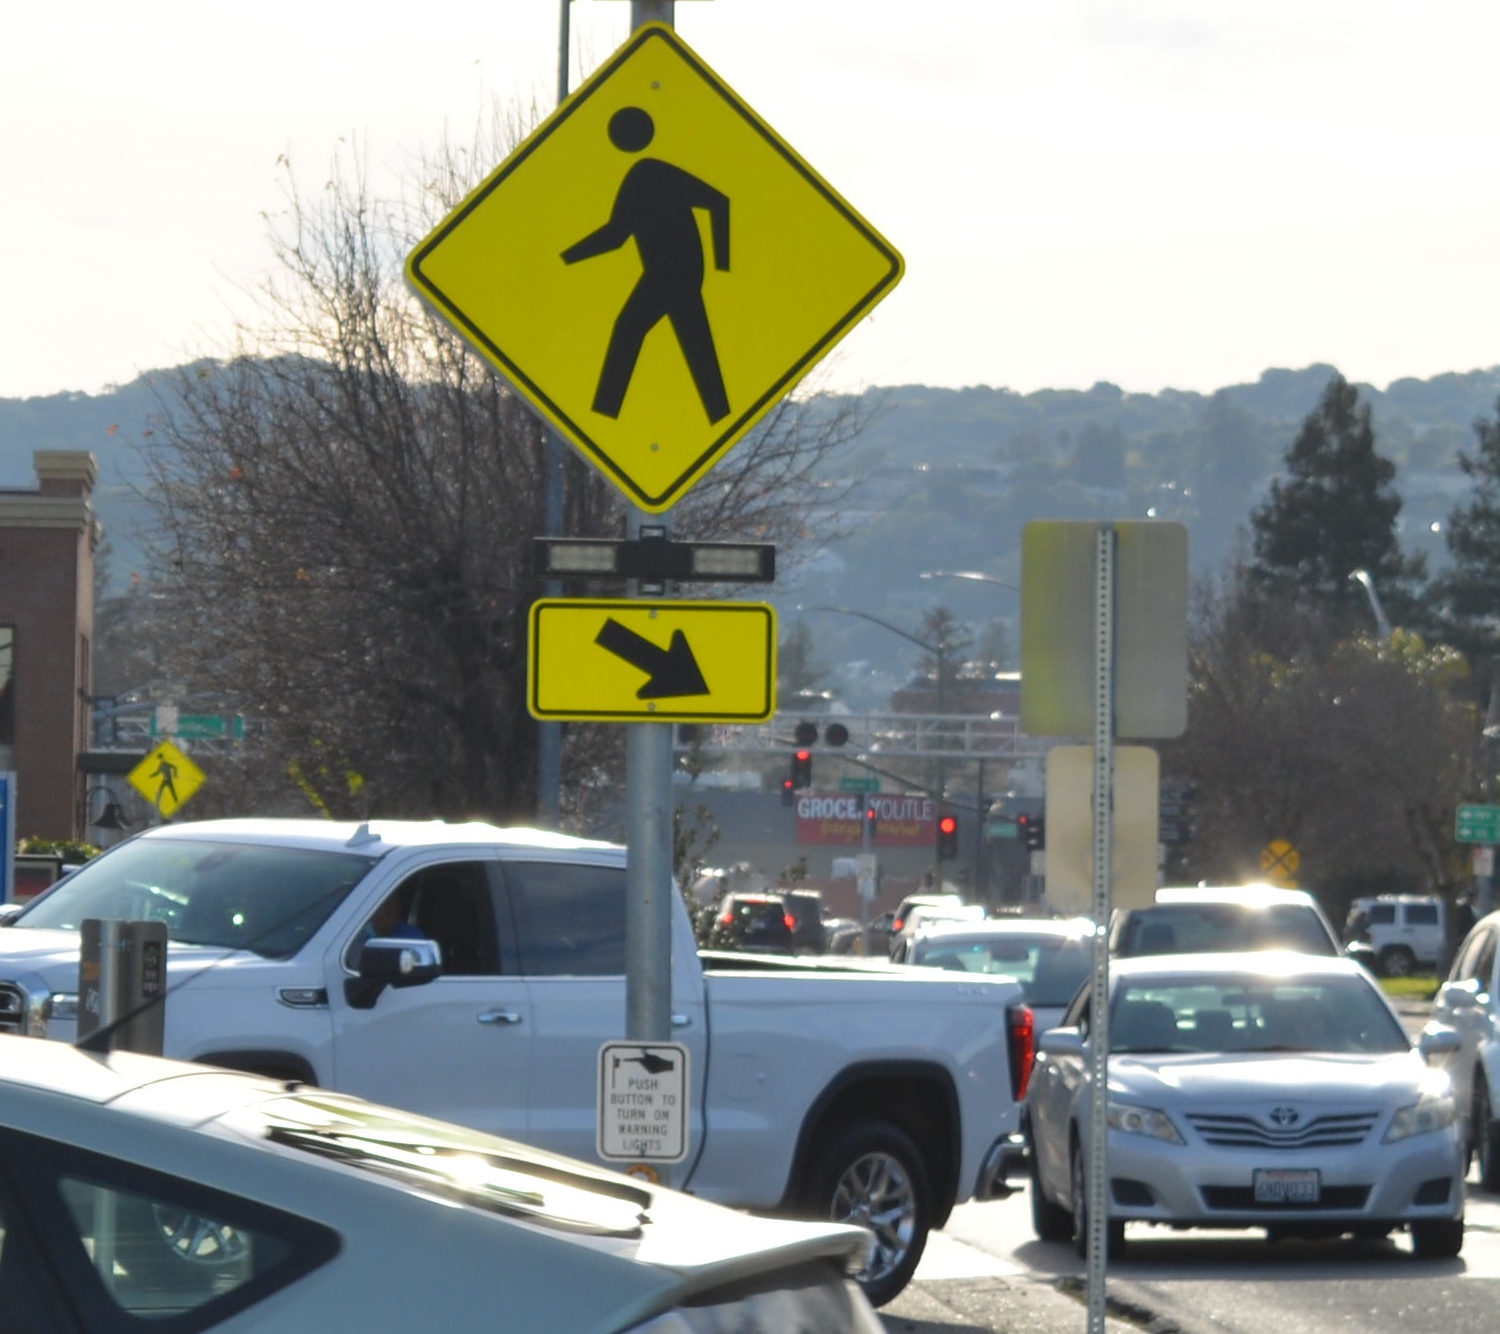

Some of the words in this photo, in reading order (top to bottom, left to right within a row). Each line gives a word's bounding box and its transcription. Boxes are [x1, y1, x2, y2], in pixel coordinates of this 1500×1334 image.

[797, 797, 880, 820] GROCEY
[881, 798, 934, 821] OUTLE
[628, 1078, 658, 1090] PUSH
[610, 1093, 653, 1106] BUTTON
[662, 1094, 676, 1106] TO
[617, 1108, 646, 1120] TURN
[654, 1109, 670, 1121] ON
[618, 1124, 668, 1136] WARNING
[622, 1139, 661, 1151] LIGHTS
